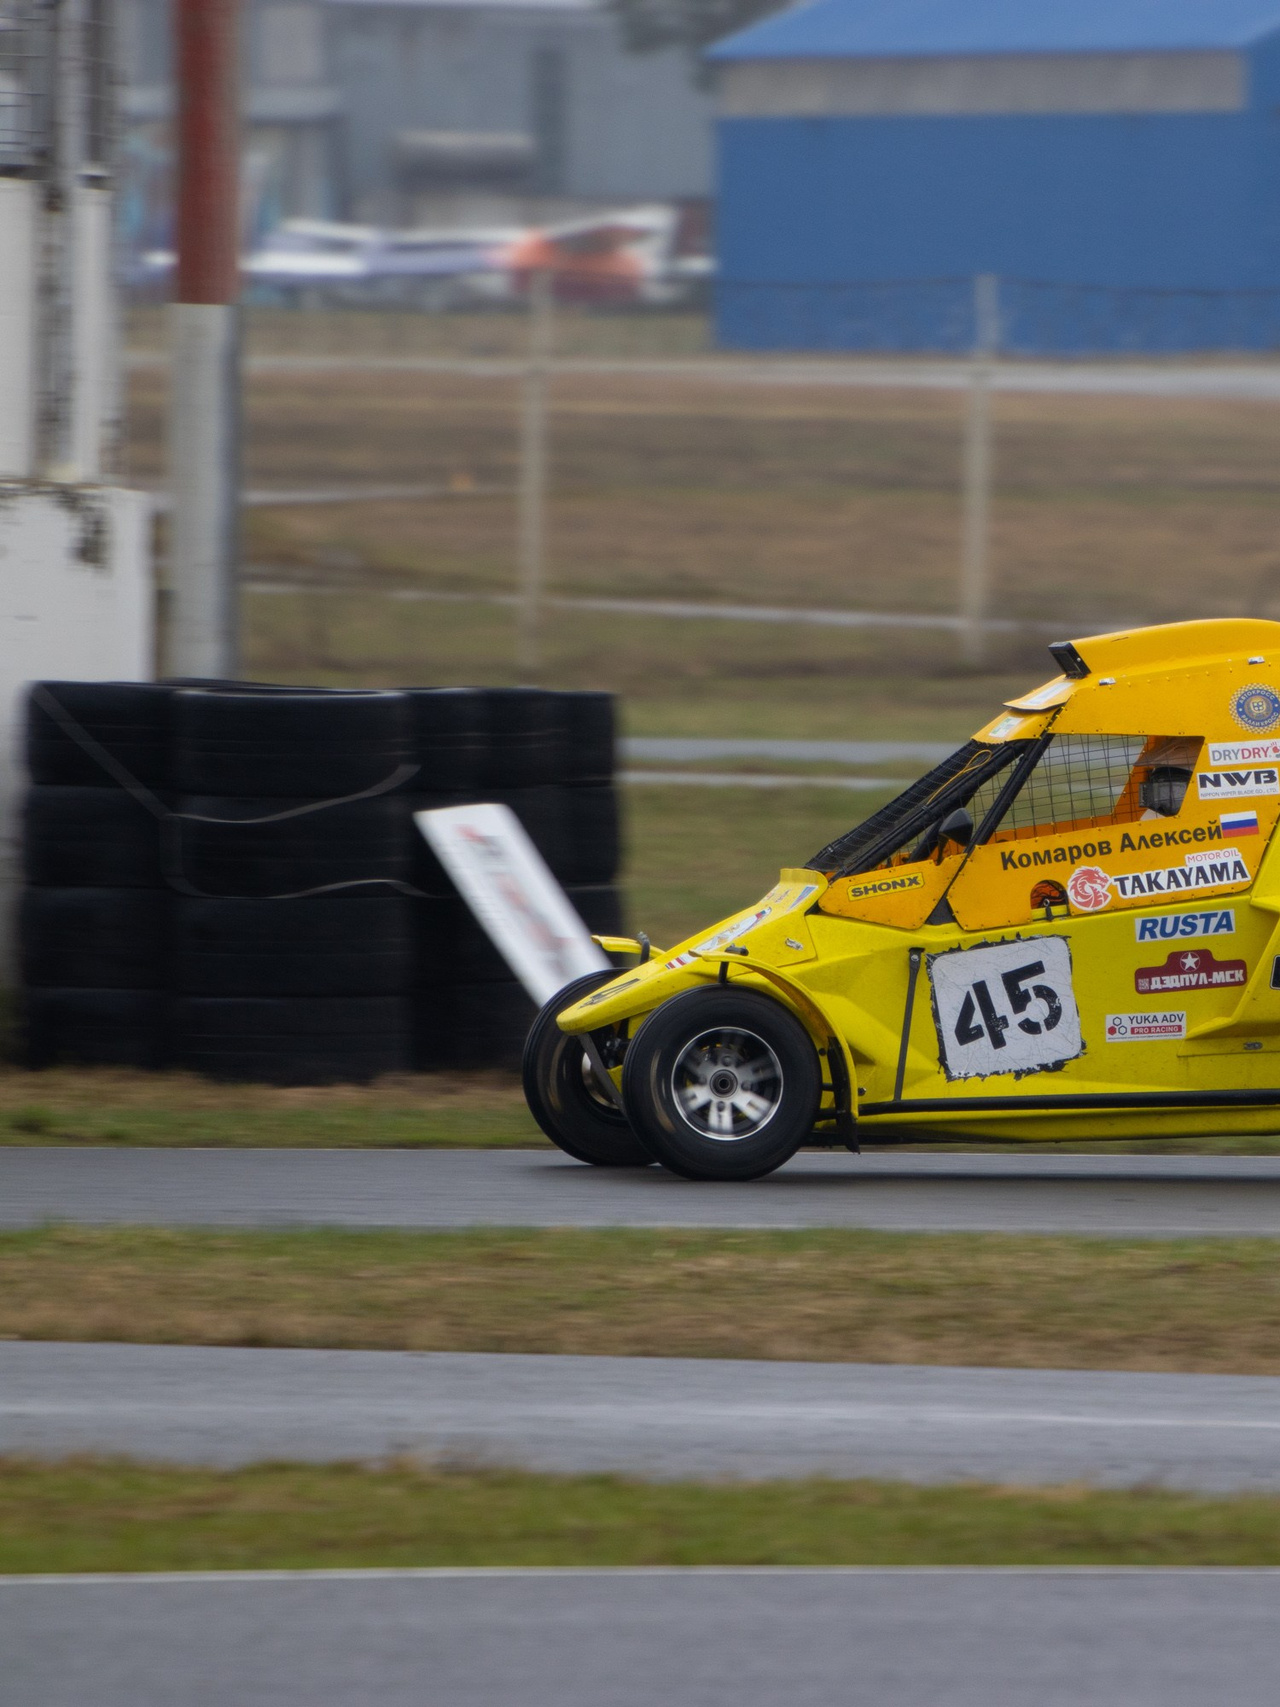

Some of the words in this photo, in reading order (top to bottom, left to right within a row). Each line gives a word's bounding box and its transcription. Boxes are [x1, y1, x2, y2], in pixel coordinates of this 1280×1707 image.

[1212, 747, 1269, 761] DRYDRY
[1199, 770, 1277, 788] NWB
[1000, 840, 1112, 870] Комаров
[1120, 820, 1222, 853] Алексей
[1187, 851, 1221, 864] MOTOR
[1223, 850, 1240, 859] OIL
[851, 876, 922, 897] SHONX
[1113, 860, 1249, 896] TAKAYAMA
[1138, 911, 1233, 941] RUSTA
[1150, 969, 1244, 990] ДЭДПУЛ-МСК
[954, 960, 1062, 1050] 45
[1128, 1015, 1159, 1025] YUKA
[1162, 1013, 1185, 1023] ADV
[1151, 1026, 1179, 1034] RACING
